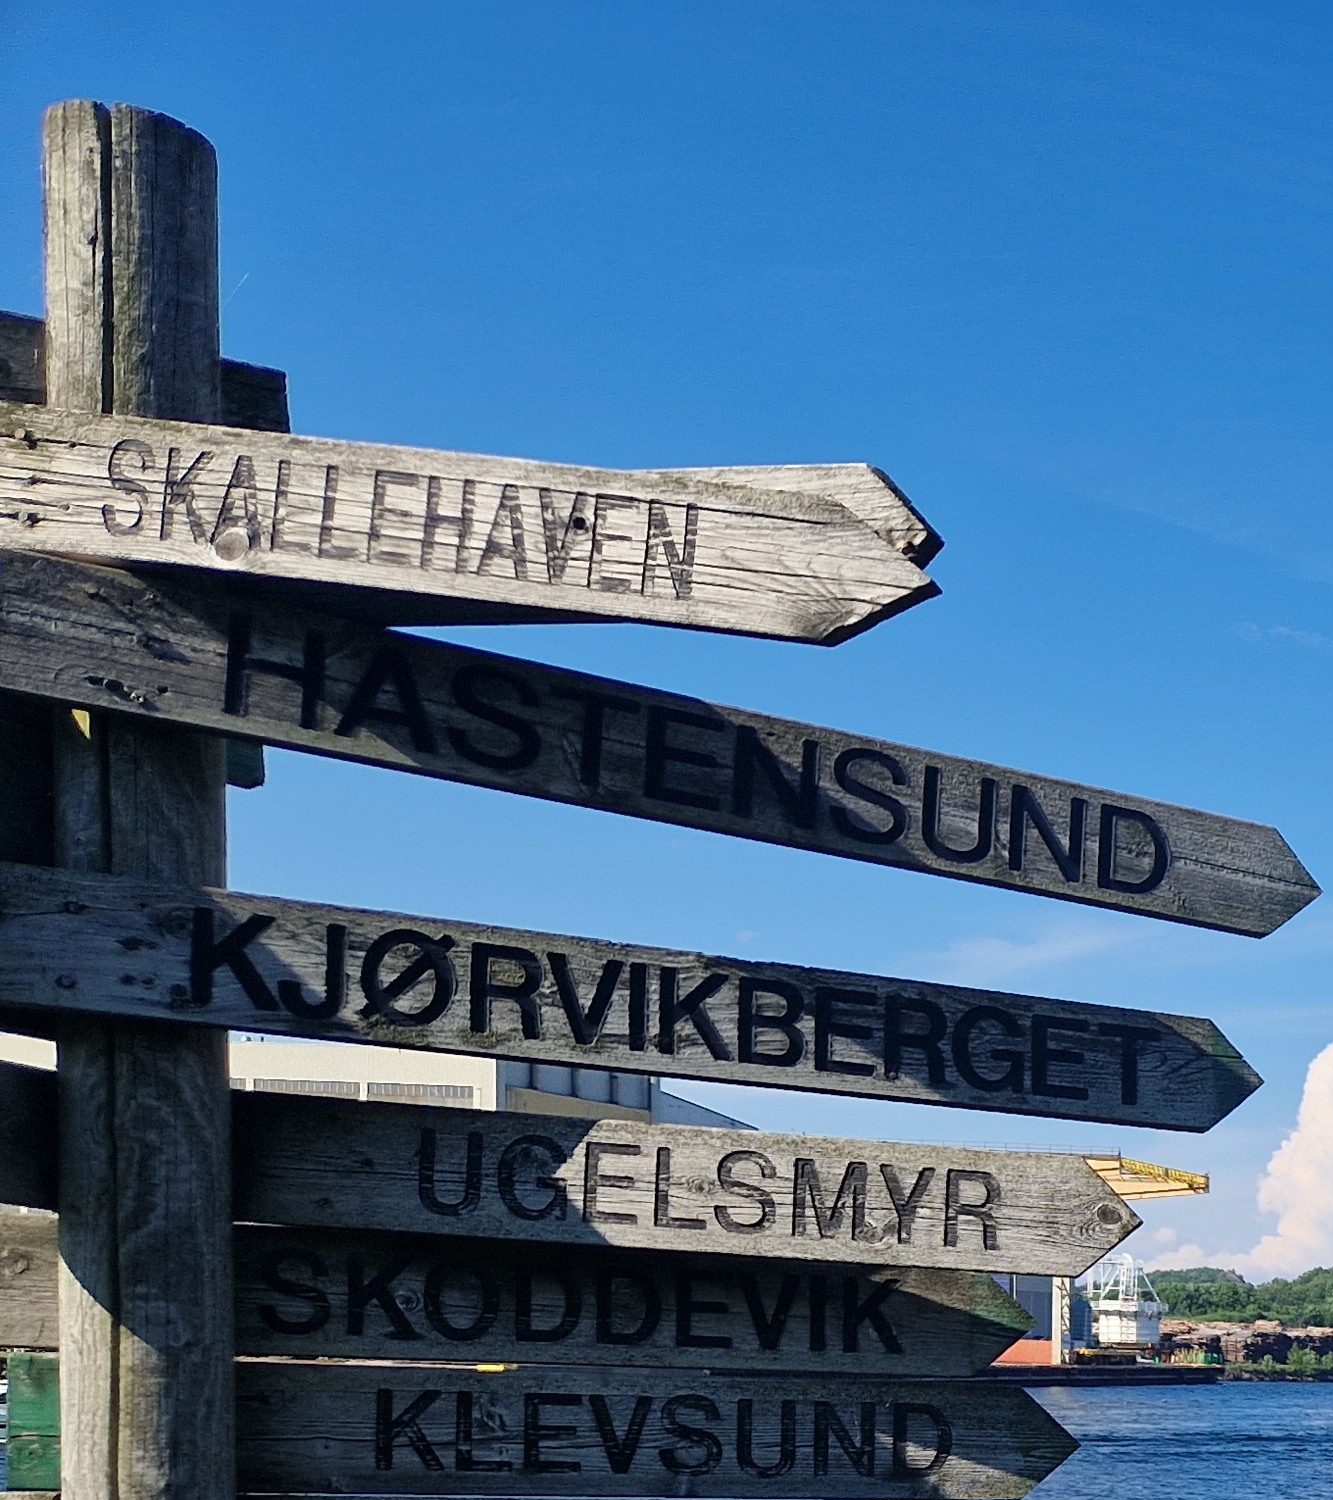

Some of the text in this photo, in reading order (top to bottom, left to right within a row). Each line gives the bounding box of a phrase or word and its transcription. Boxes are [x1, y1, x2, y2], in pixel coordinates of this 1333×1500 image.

[103, 438, 699, 600] SKALLEHAVEN
[223, 612, 1171, 894] HASTENSUND
[189, 906, 1164, 1106] KJØRVIKBERGET
[418, 1126, 1001, 1251] UGELSMYR
[257, 1247, 904, 1356] SKODDEVIK
[374, 1386, 953, 1477] KLEVSUND
